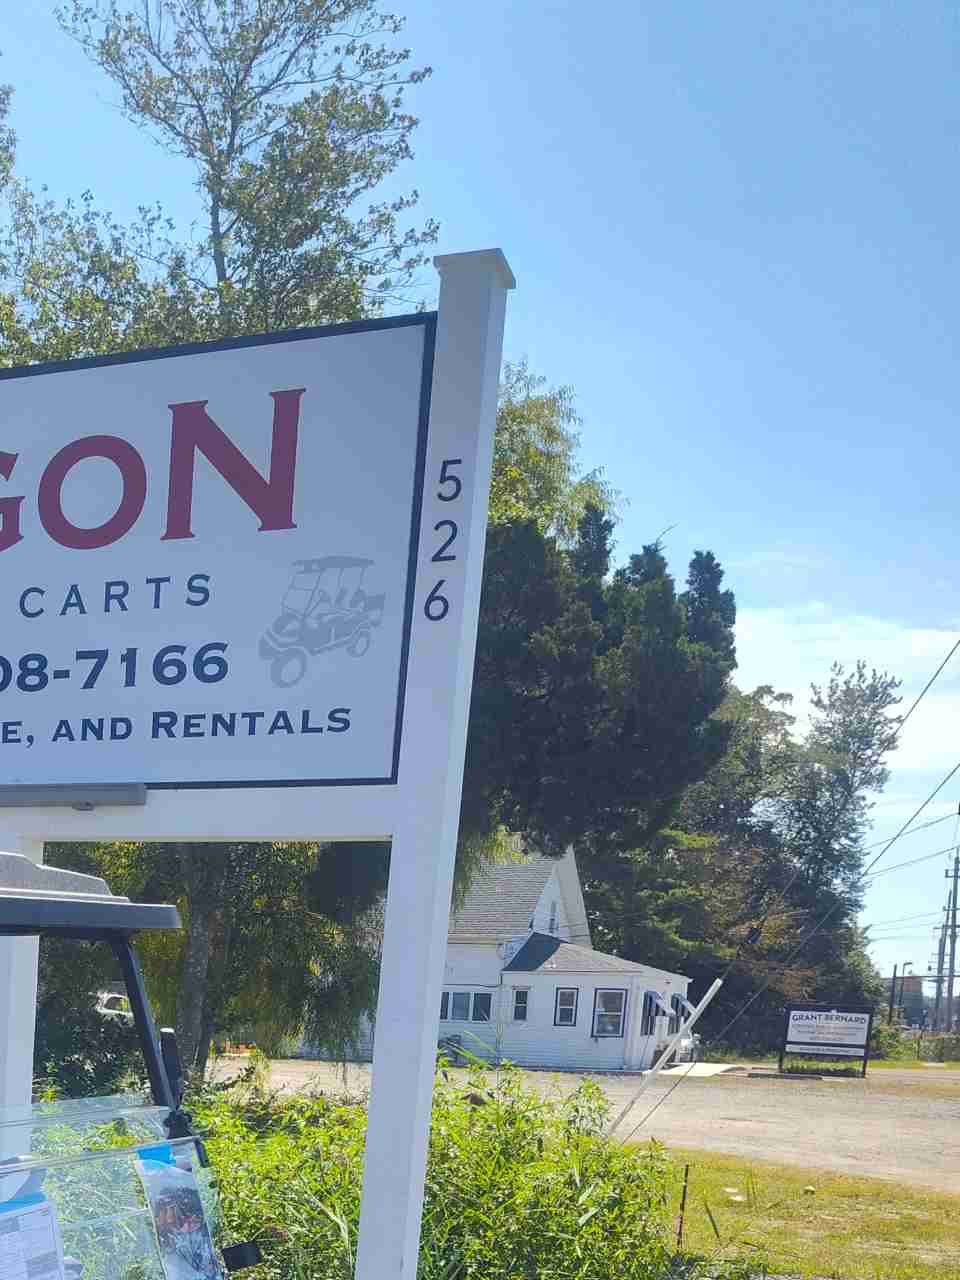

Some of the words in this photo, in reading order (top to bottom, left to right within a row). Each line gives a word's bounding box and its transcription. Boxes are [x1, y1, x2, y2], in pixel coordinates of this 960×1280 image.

[19, 573, 211, 619] CARTS
[51, 716, 134, 743] AND
[151, 707, 352, 739] RENTALS
[791, 1014, 822, 1022] GRANT
[824, 1014, 866, 1023] BERNARD
